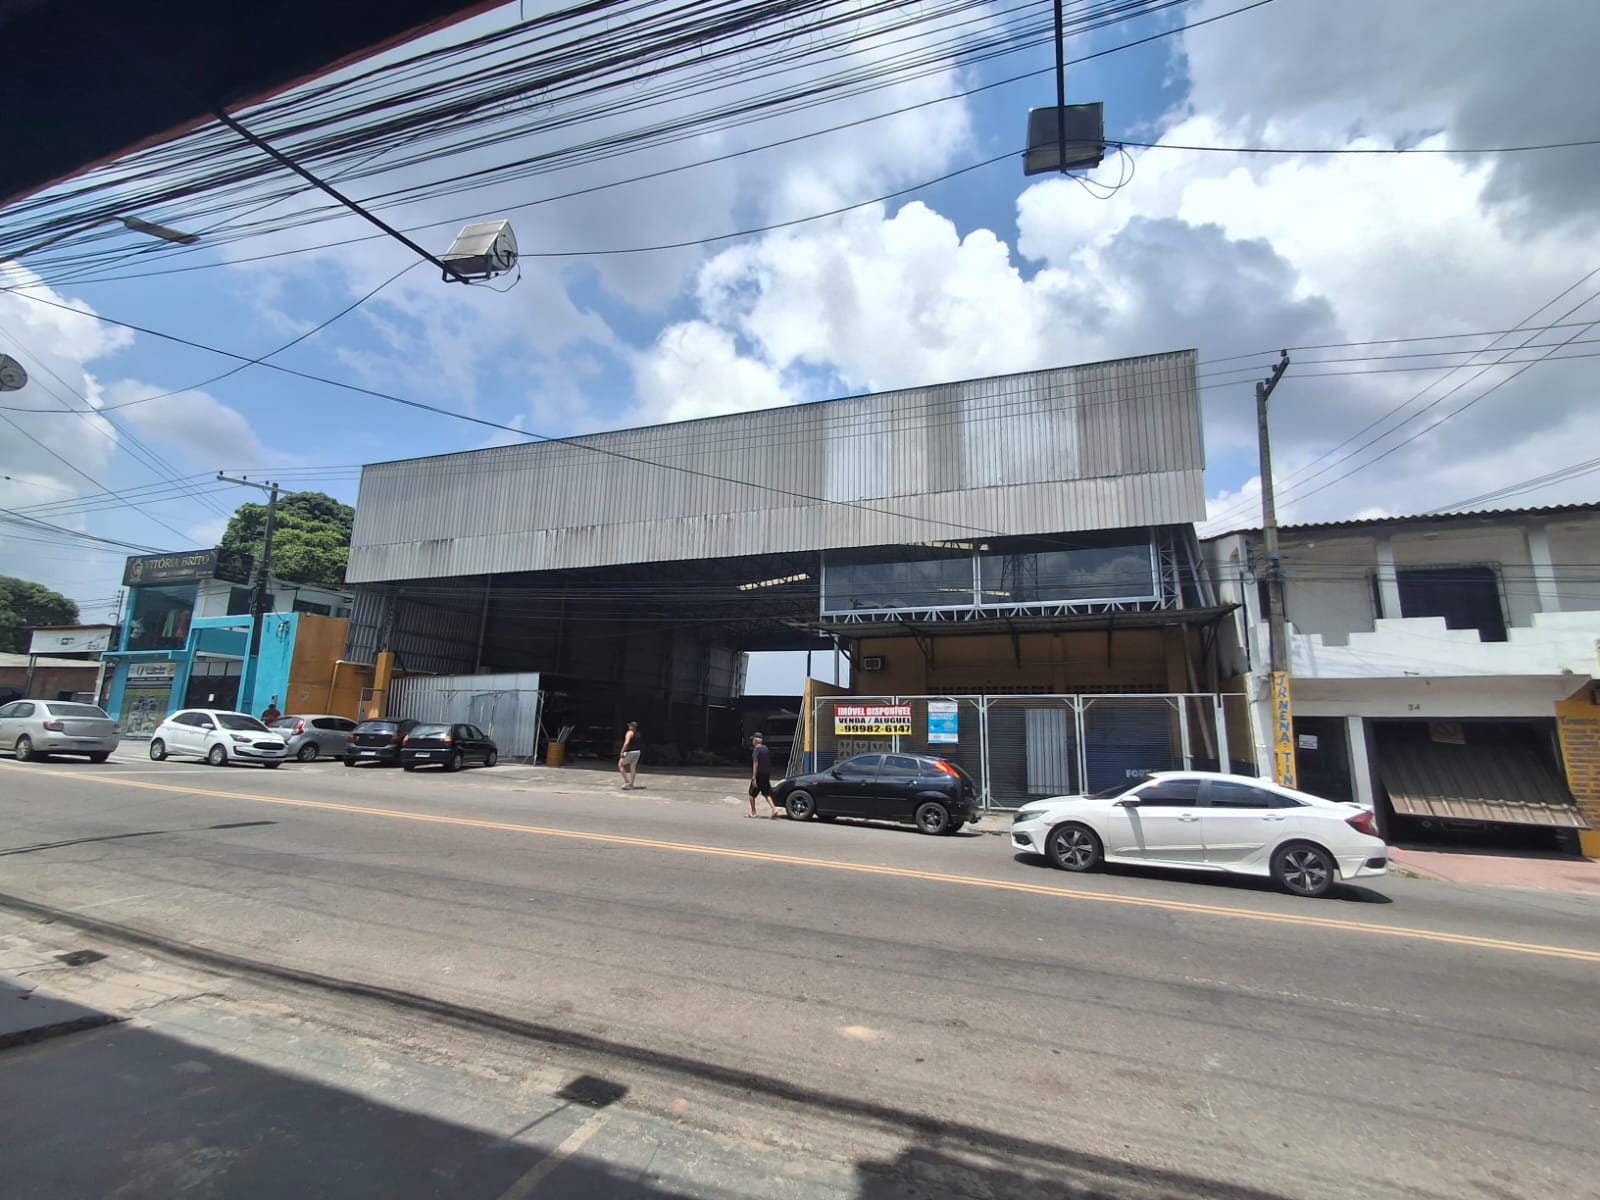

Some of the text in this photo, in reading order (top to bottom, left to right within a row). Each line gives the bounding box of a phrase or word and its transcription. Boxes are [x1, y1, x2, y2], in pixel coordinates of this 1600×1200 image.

[837, 706, 911, 716] IMÓVEL DISPONÍVEL
[844, 725, 911, 733] 99982-6147
